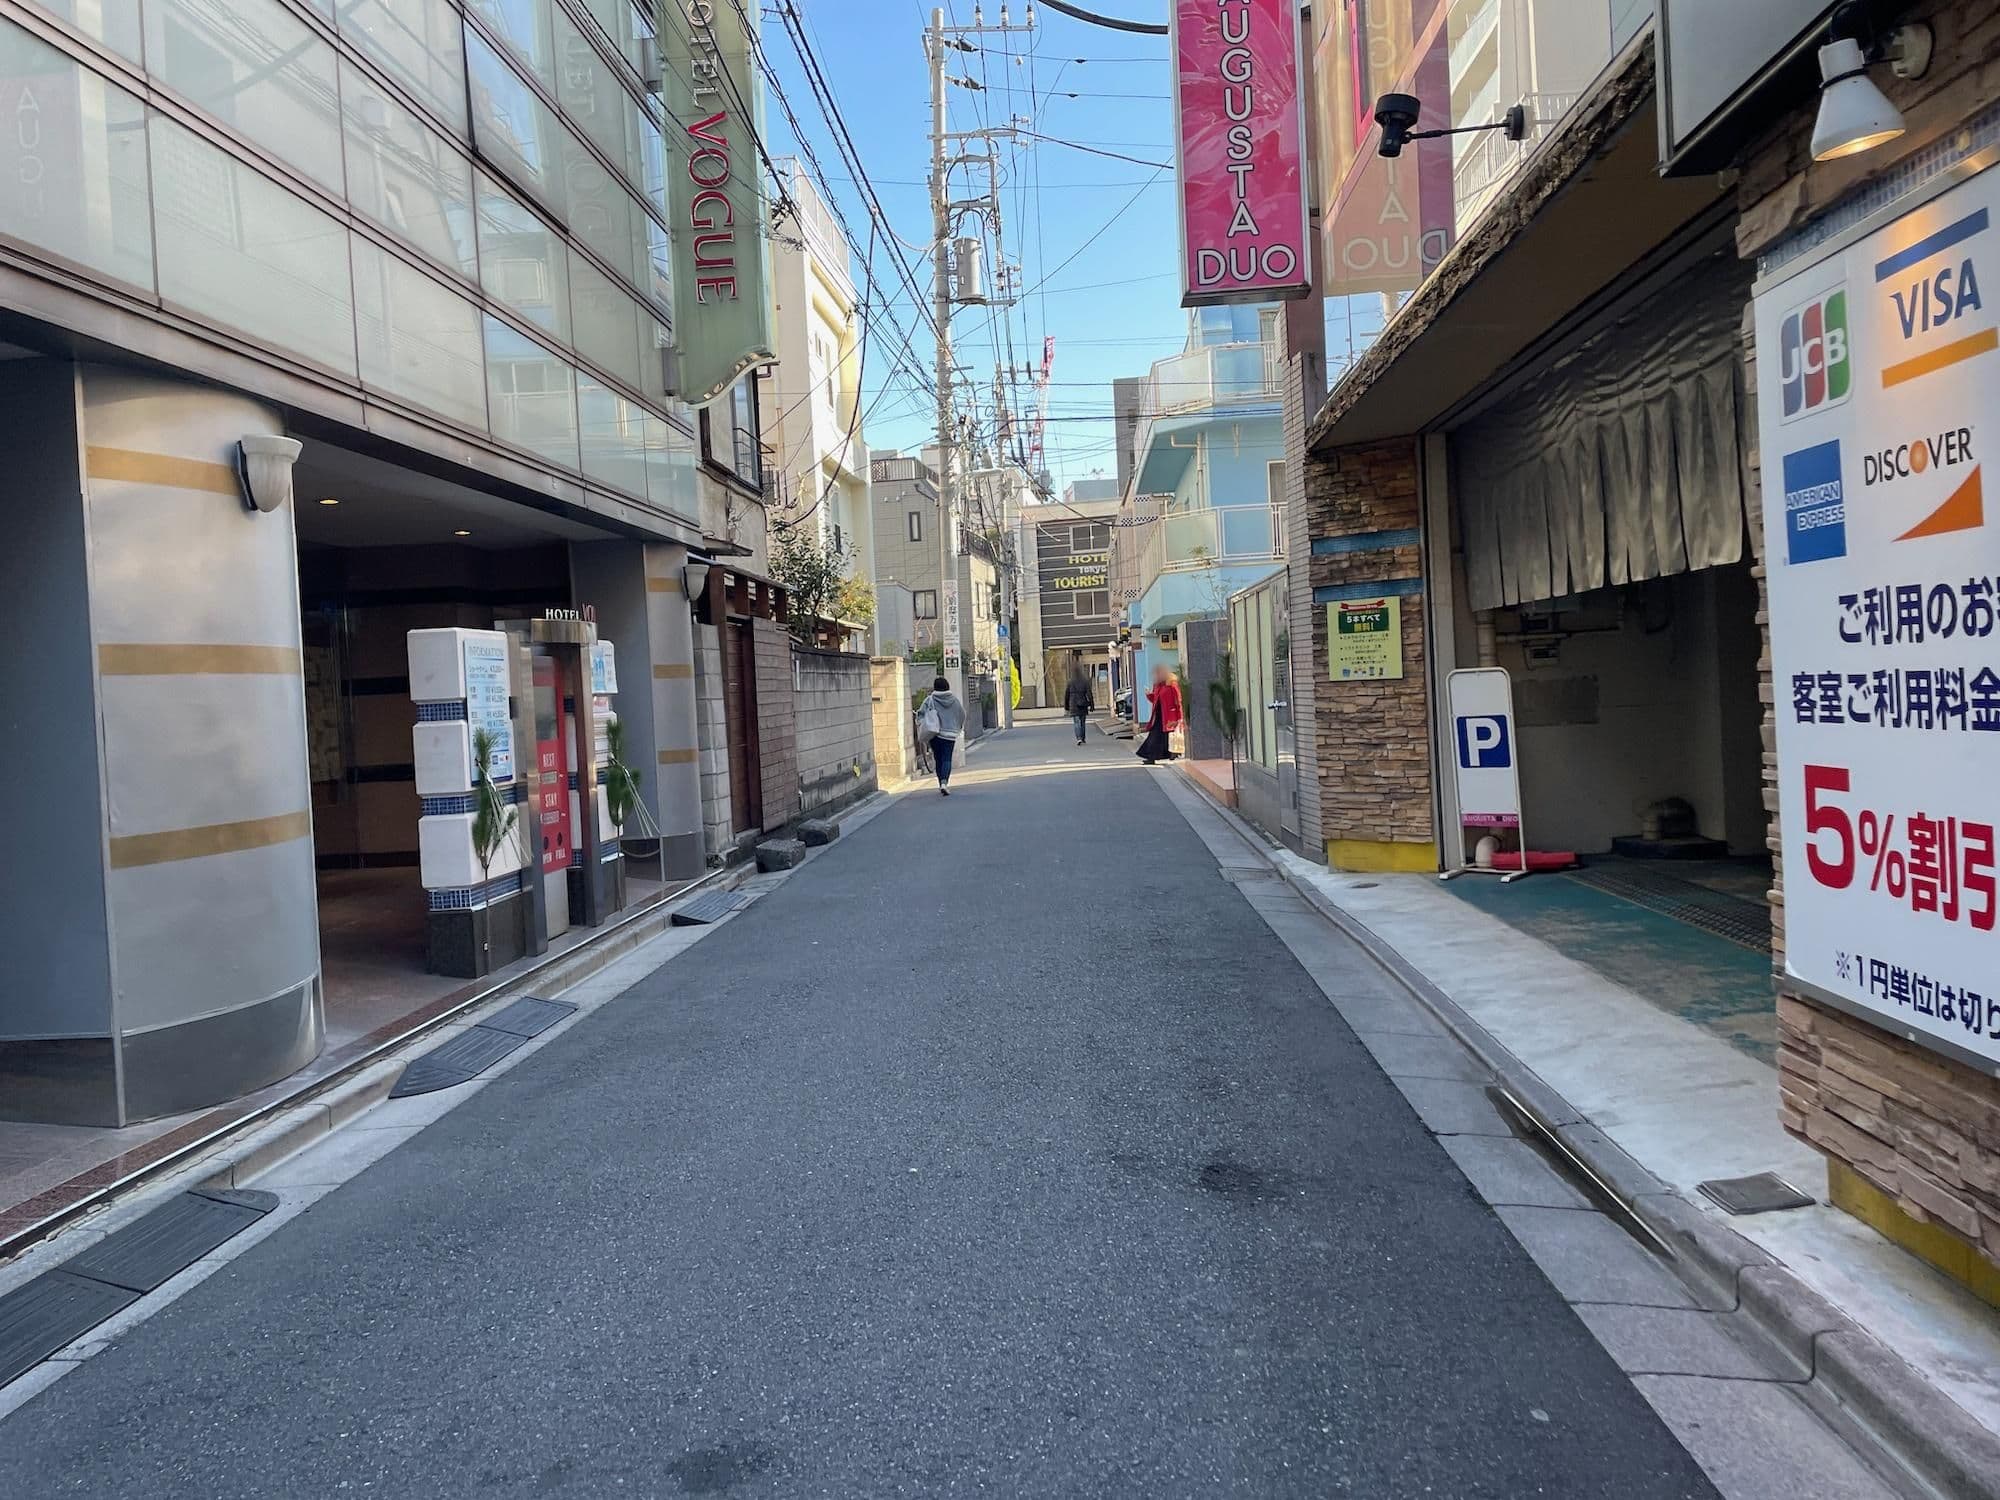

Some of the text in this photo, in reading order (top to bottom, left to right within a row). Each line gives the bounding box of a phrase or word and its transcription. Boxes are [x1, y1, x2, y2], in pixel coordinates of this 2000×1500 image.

[1218, 0, 1260, 238] UGUSTA
[687, 110, 737, 305] VOGUE
[1197, 244, 1297, 285] DUO
[1889, 257, 1982, 340] VISA
[1781, 327, 1847, 385] JCB
[1864, 427, 1974, 486] DISCOVER
[1785, 480, 1841, 511] AMERICAN
[1797, 504, 1845, 531] EXPRESS
[1054, 574, 1105, 589] TOURIST
[1079, 565, 1107, 574] Tokyo
[545, 608, 580, 620] HOTEL
[1346, 614, 1381, 624] 5本すべて
[1838, 576, 2000, 645] ご利用のお
[1466, 717, 1502, 768] P
